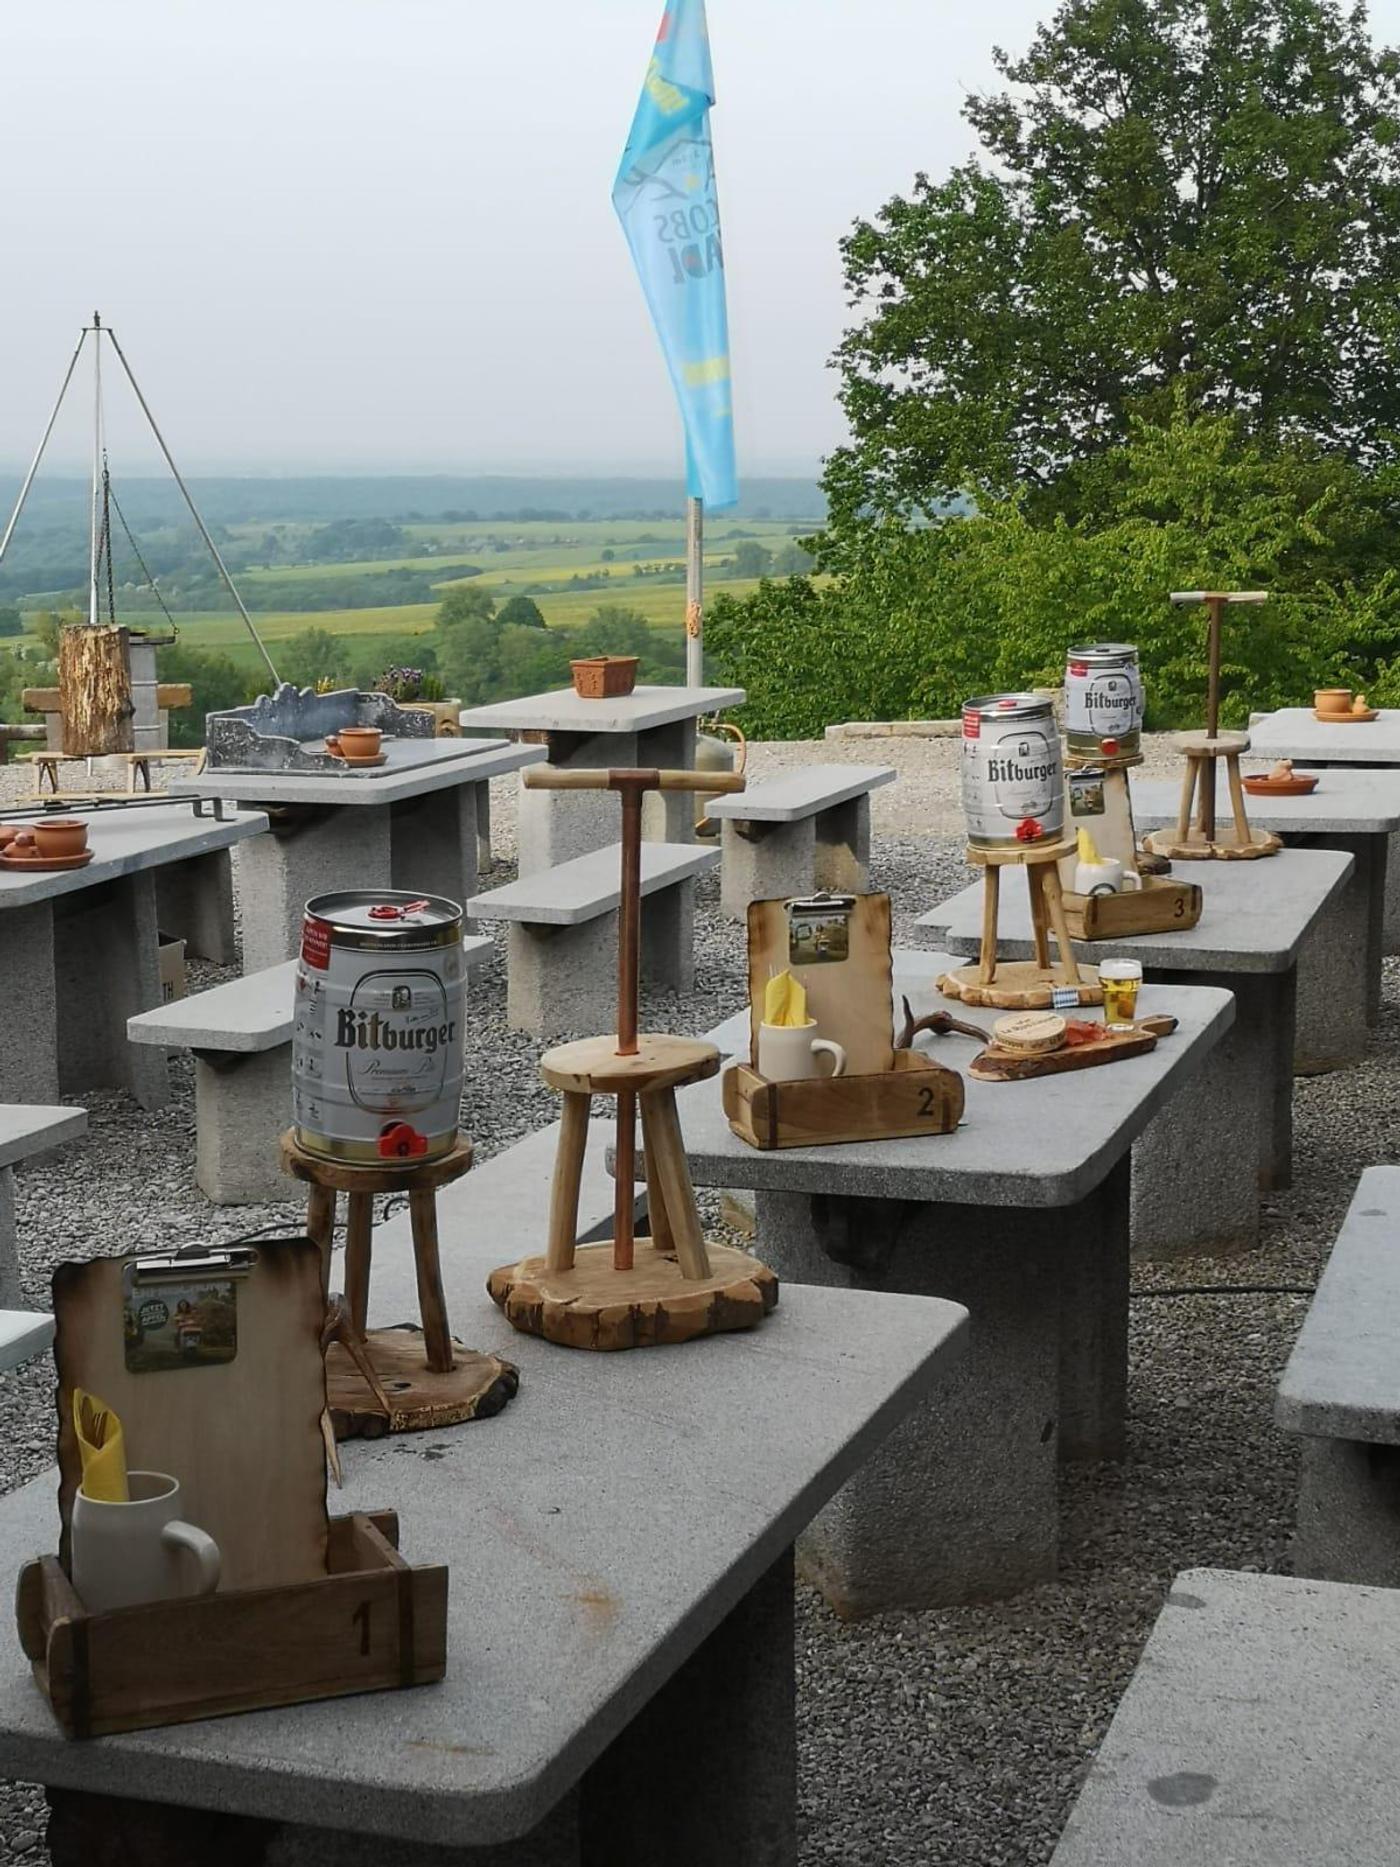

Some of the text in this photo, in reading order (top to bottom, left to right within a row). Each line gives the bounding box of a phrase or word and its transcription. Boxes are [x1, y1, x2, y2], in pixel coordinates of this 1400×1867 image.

[1084, 692, 1137, 711] Bitburger
[988, 759, 1057, 782] Bitburger
[1173, 898, 1185, 918] 3
[334, 1008, 455, 1054] Bitburger
[917, 1087, 935, 1117] 2
[351, 1601, 371, 1657] 1
